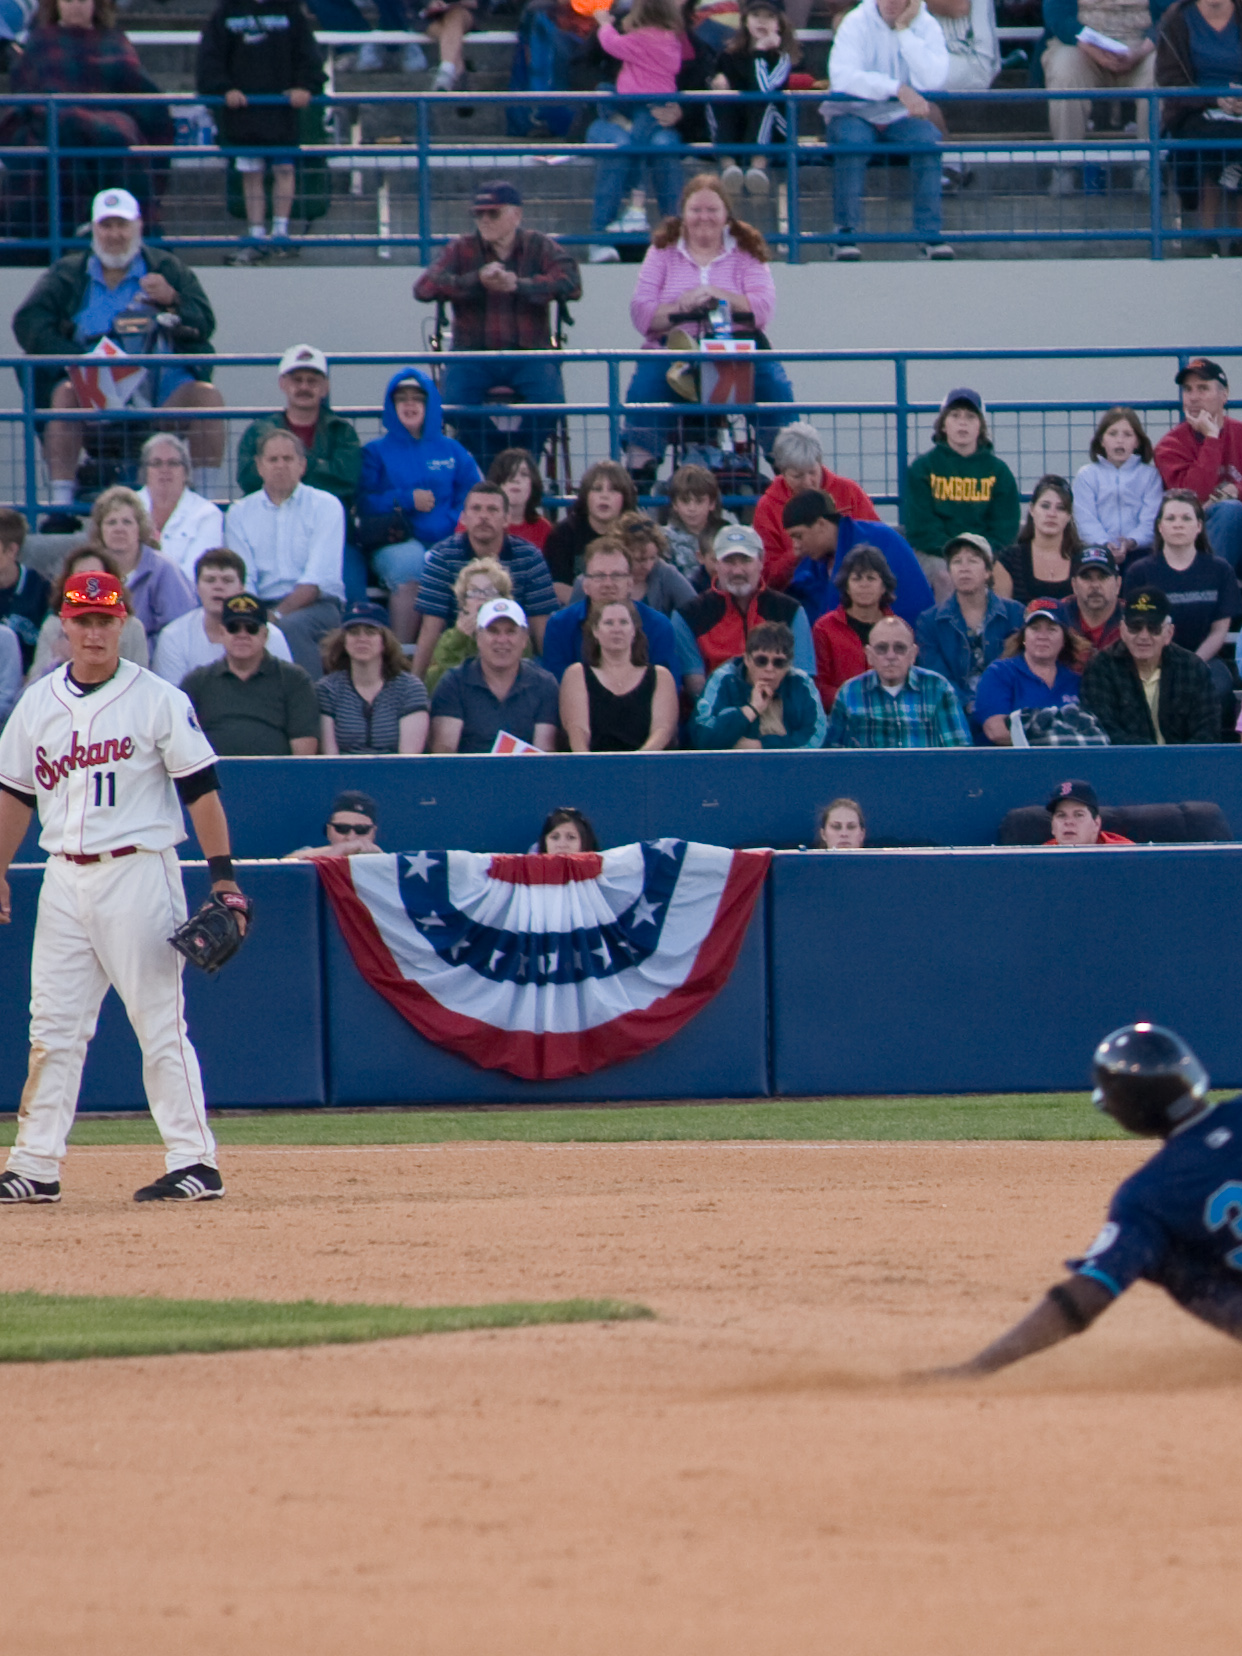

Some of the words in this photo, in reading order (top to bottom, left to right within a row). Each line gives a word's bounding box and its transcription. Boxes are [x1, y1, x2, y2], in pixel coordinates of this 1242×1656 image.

[930, 473, 997, 502] UMBOLD
[35, 730, 135, 791] Spokane
[93, 771, 115, 807] 11
